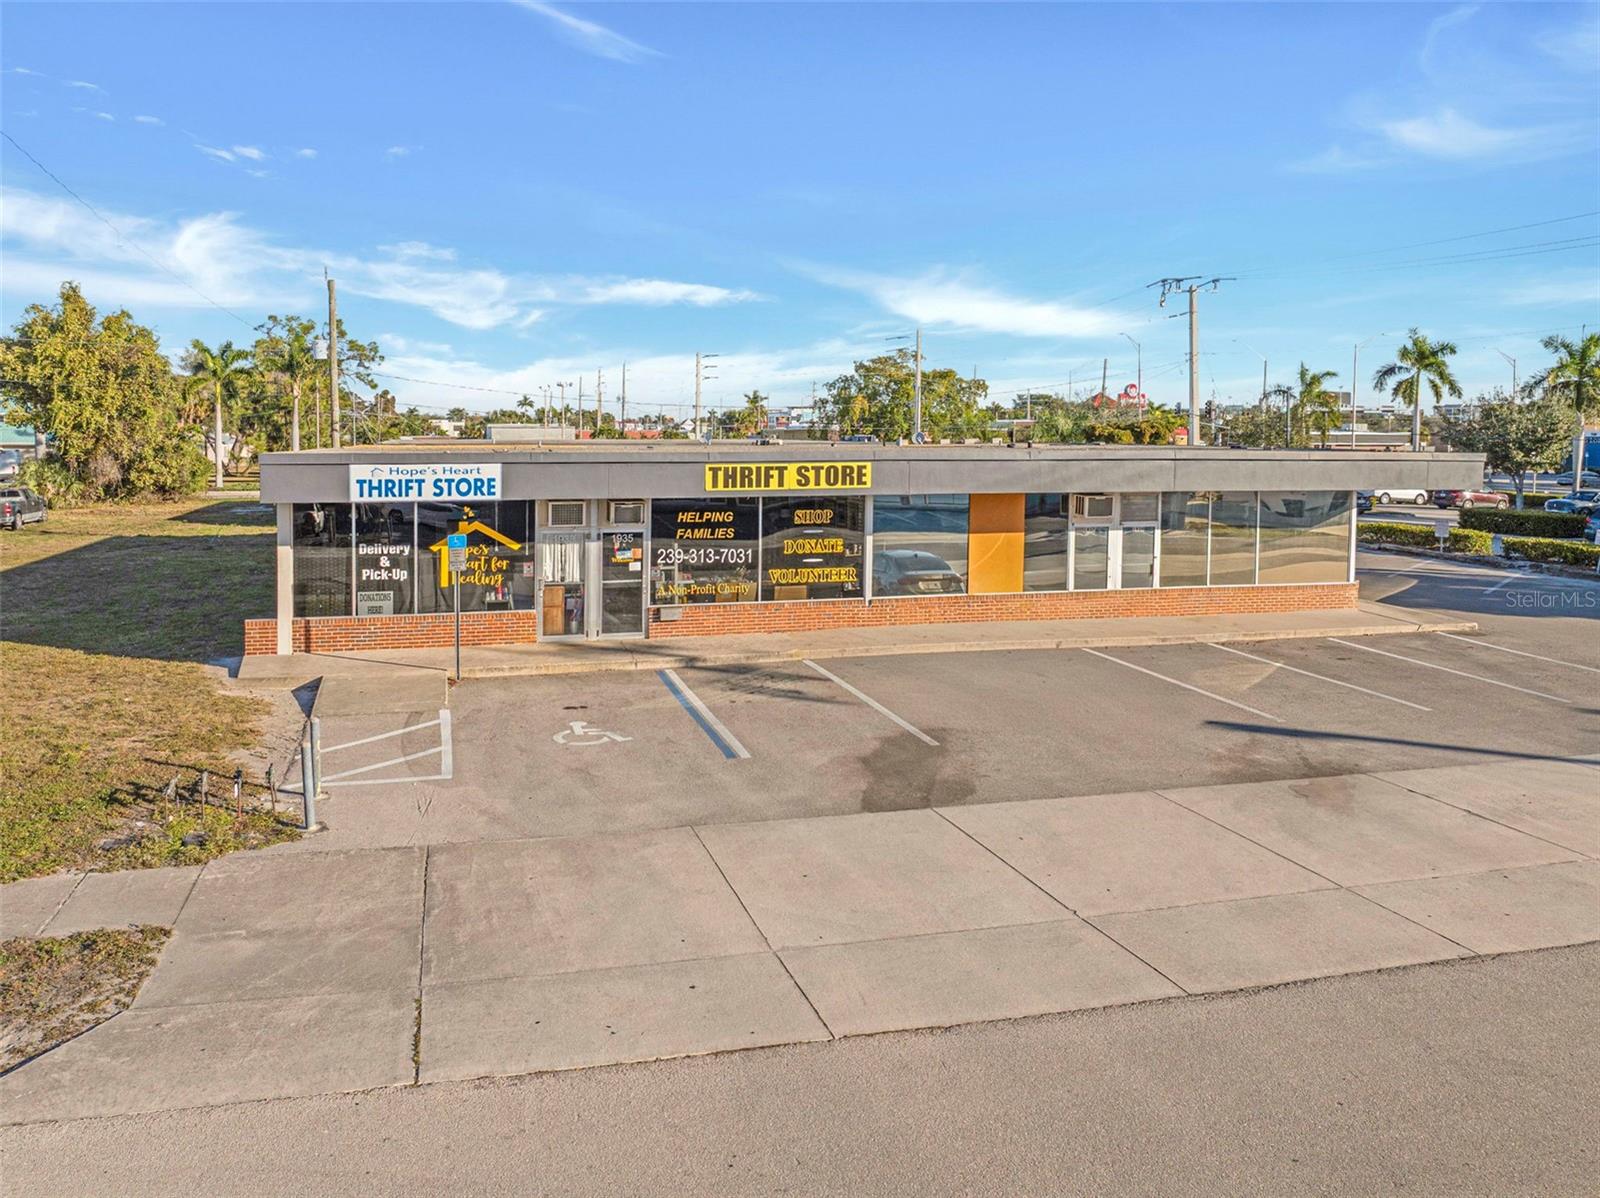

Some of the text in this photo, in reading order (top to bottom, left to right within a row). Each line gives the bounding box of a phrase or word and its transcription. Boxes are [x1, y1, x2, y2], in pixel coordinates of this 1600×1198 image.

[389, 466, 481, 477] Hope's Heart
[708, 465, 867, 489] THRIFT STORE
[356, 477, 496, 498] THRIFT STORE
[677, 511, 734, 523] HELPING
[794, 509, 833, 525] SHOP
[612, 533, 634, 543] 1935
[676, 528, 735, 539] FAMILIES
[359, 543, 411, 556] Delivery
[783, 538, 844, 555] DONATE
[380, 556, 391, 567] &
[657, 548, 753, 564] 239-313-7031
[491, 556, 510, 572] for
[361, 568, 408, 581] Pick-Up
[768, 567, 857, 584] VOLUNTEER
[667, 583, 716, 595] Non-Profit
[717, 582, 750, 595] Charity
[359, 592, 392, 603] DONATIONS
